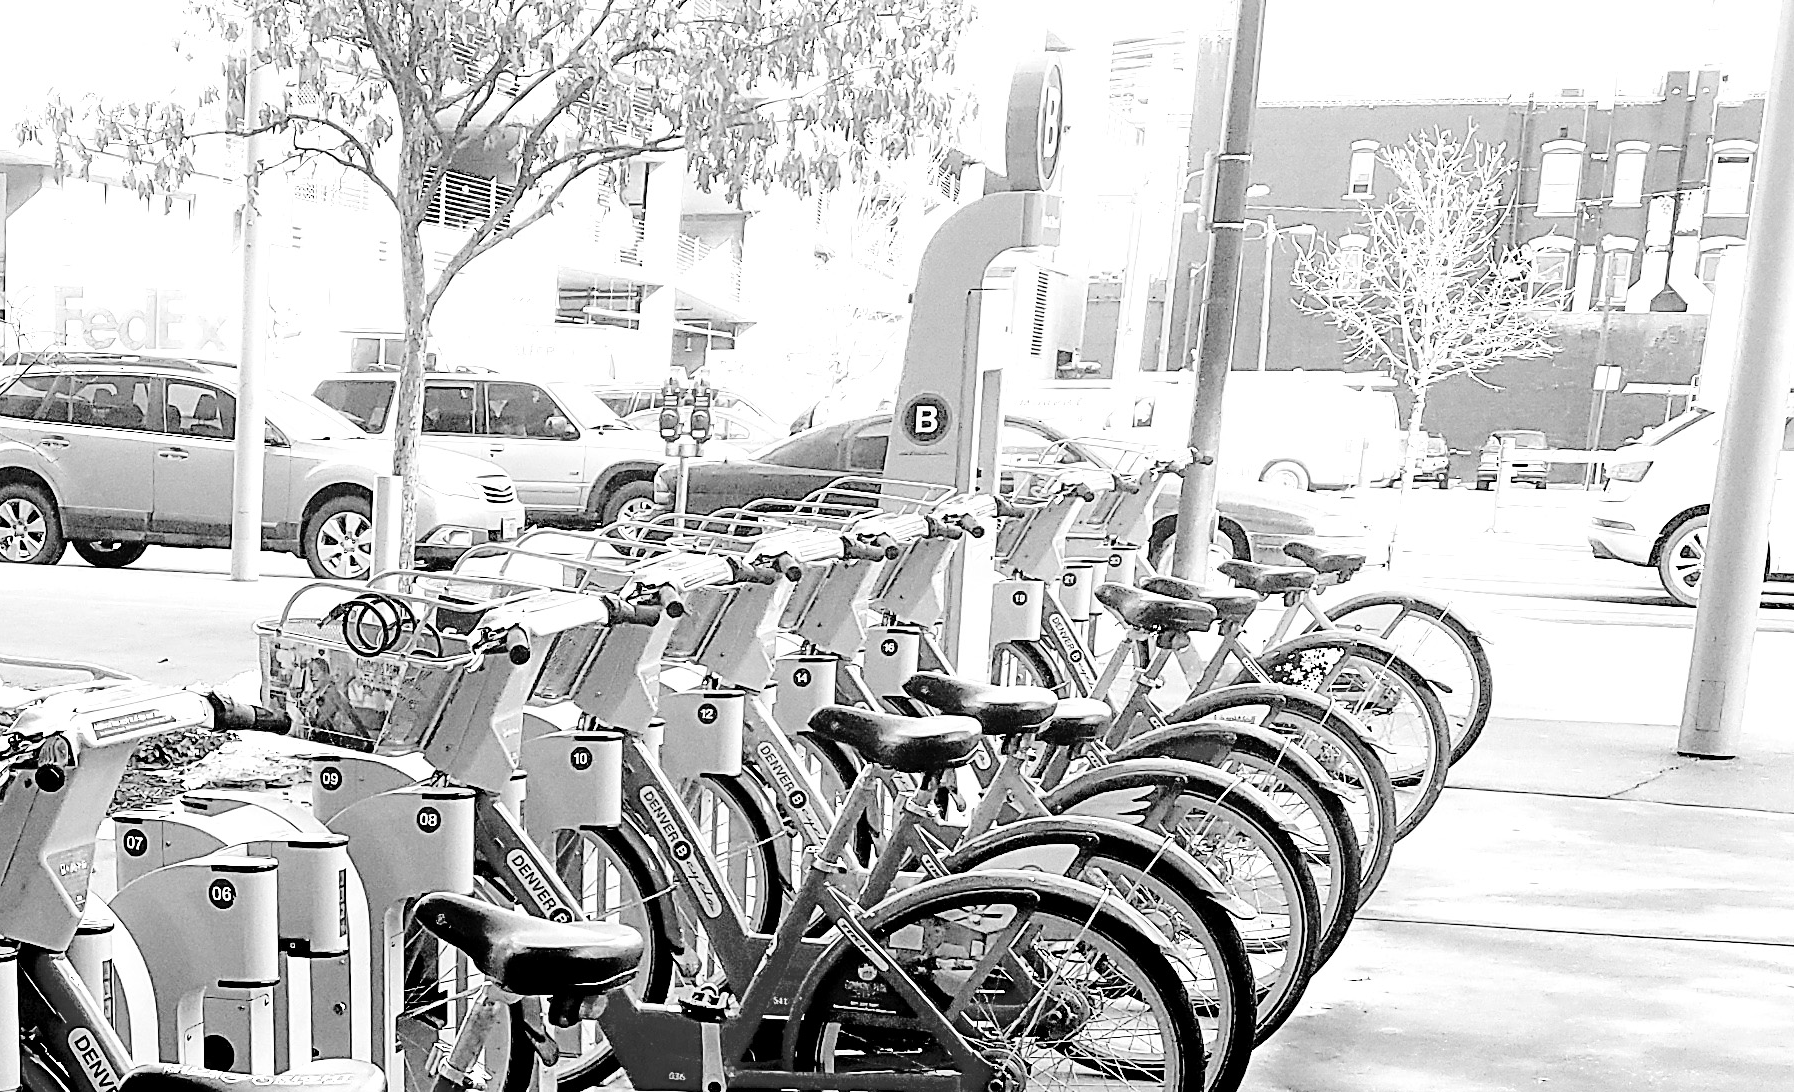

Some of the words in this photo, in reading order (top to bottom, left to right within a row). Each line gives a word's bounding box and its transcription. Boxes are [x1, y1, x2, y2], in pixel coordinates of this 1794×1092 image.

[54, 285, 227, 352] FedEx
[914, 404, 940, 434] B
[795, 672, 808, 683] 14
[700, 708, 714, 720] 12
[572, 752, 588, 765] 10
[760, 745, 795, 792] DENVER
[321, 772, 339, 785] 09
[419, 813, 438, 827] 08
[643, 791, 679, 842] DENVER
[126, 835, 144, 850] 07
[511, 854, 557, 911] DENVER
[211, 885, 233, 901] 06
